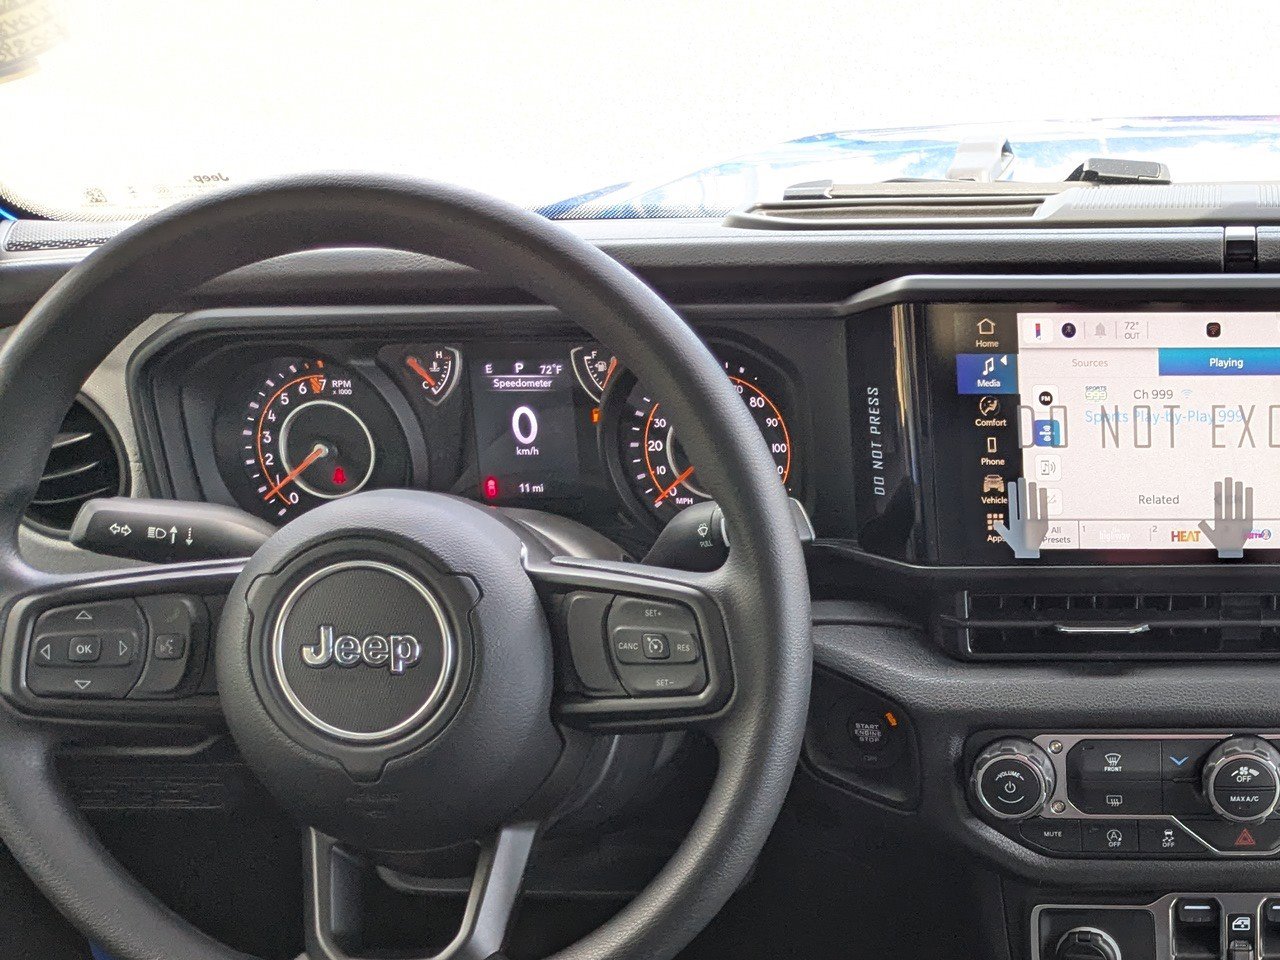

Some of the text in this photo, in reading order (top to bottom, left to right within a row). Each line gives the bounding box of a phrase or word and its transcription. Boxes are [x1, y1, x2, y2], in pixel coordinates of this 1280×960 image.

[1124, 332, 1140, 340] OUT
[975, 339, 999, 348] Home
[514, 362, 524, 373] P
[1072, 358, 1108, 367] Sources
[1209, 357, 1244, 369] Playing
[485, 364, 493, 373] E
[298, 382, 307, 394] 6
[318, 379, 326, 390] 7
[332, 380, 352, 388] RPM
[493, 378, 552, 388] Speedometer
[977, 379, 1001, 387] Media
[280, 393, 290, 405] 5
[1133, 389, 1174, 400] Ch 999
[749, 396, 765, 408] 80
[267, 410, 276, 421] 4
[511, 405, 538, 445] 0
[653, 418, 667, 428] 30
[765, 417, 778, 428] 90
[974, 419, 1007, 427] Comfort
[1017, 404, 1068, 449] DO
[1100, 404, 1180, 448] NOT
[262, 431, 272, 443] 3
[867, 386, 886, 496] DO NOT PRESS
[516, 446, 539, 457] km/h
[648, 440, 663, 452] 20
[772, 443, 787, 453] 100
[265, 453, 274, 465] 2
[980, 457, 1006, 466] Phone
[656, 465, 666, 475] 10
[519, 483, 544, 493] 11 mi
[289, 492, 299, 504] 0
[675, 497, 693, 505] MPH
[981, 496, 1008, 504] Vehicle
[1138, 494, 1179, 505] Related
[1171, 530, 1201, 542] HEAT
[700, 540, 713, 548] PULL
[76, 644, 92, 655] OK
[301, 624, 421, 676] Jeep
[618, 642, 639, 651] CANC
[677, 643, 690, 651] RES
[1236, 775, 1251, 783] OFF
